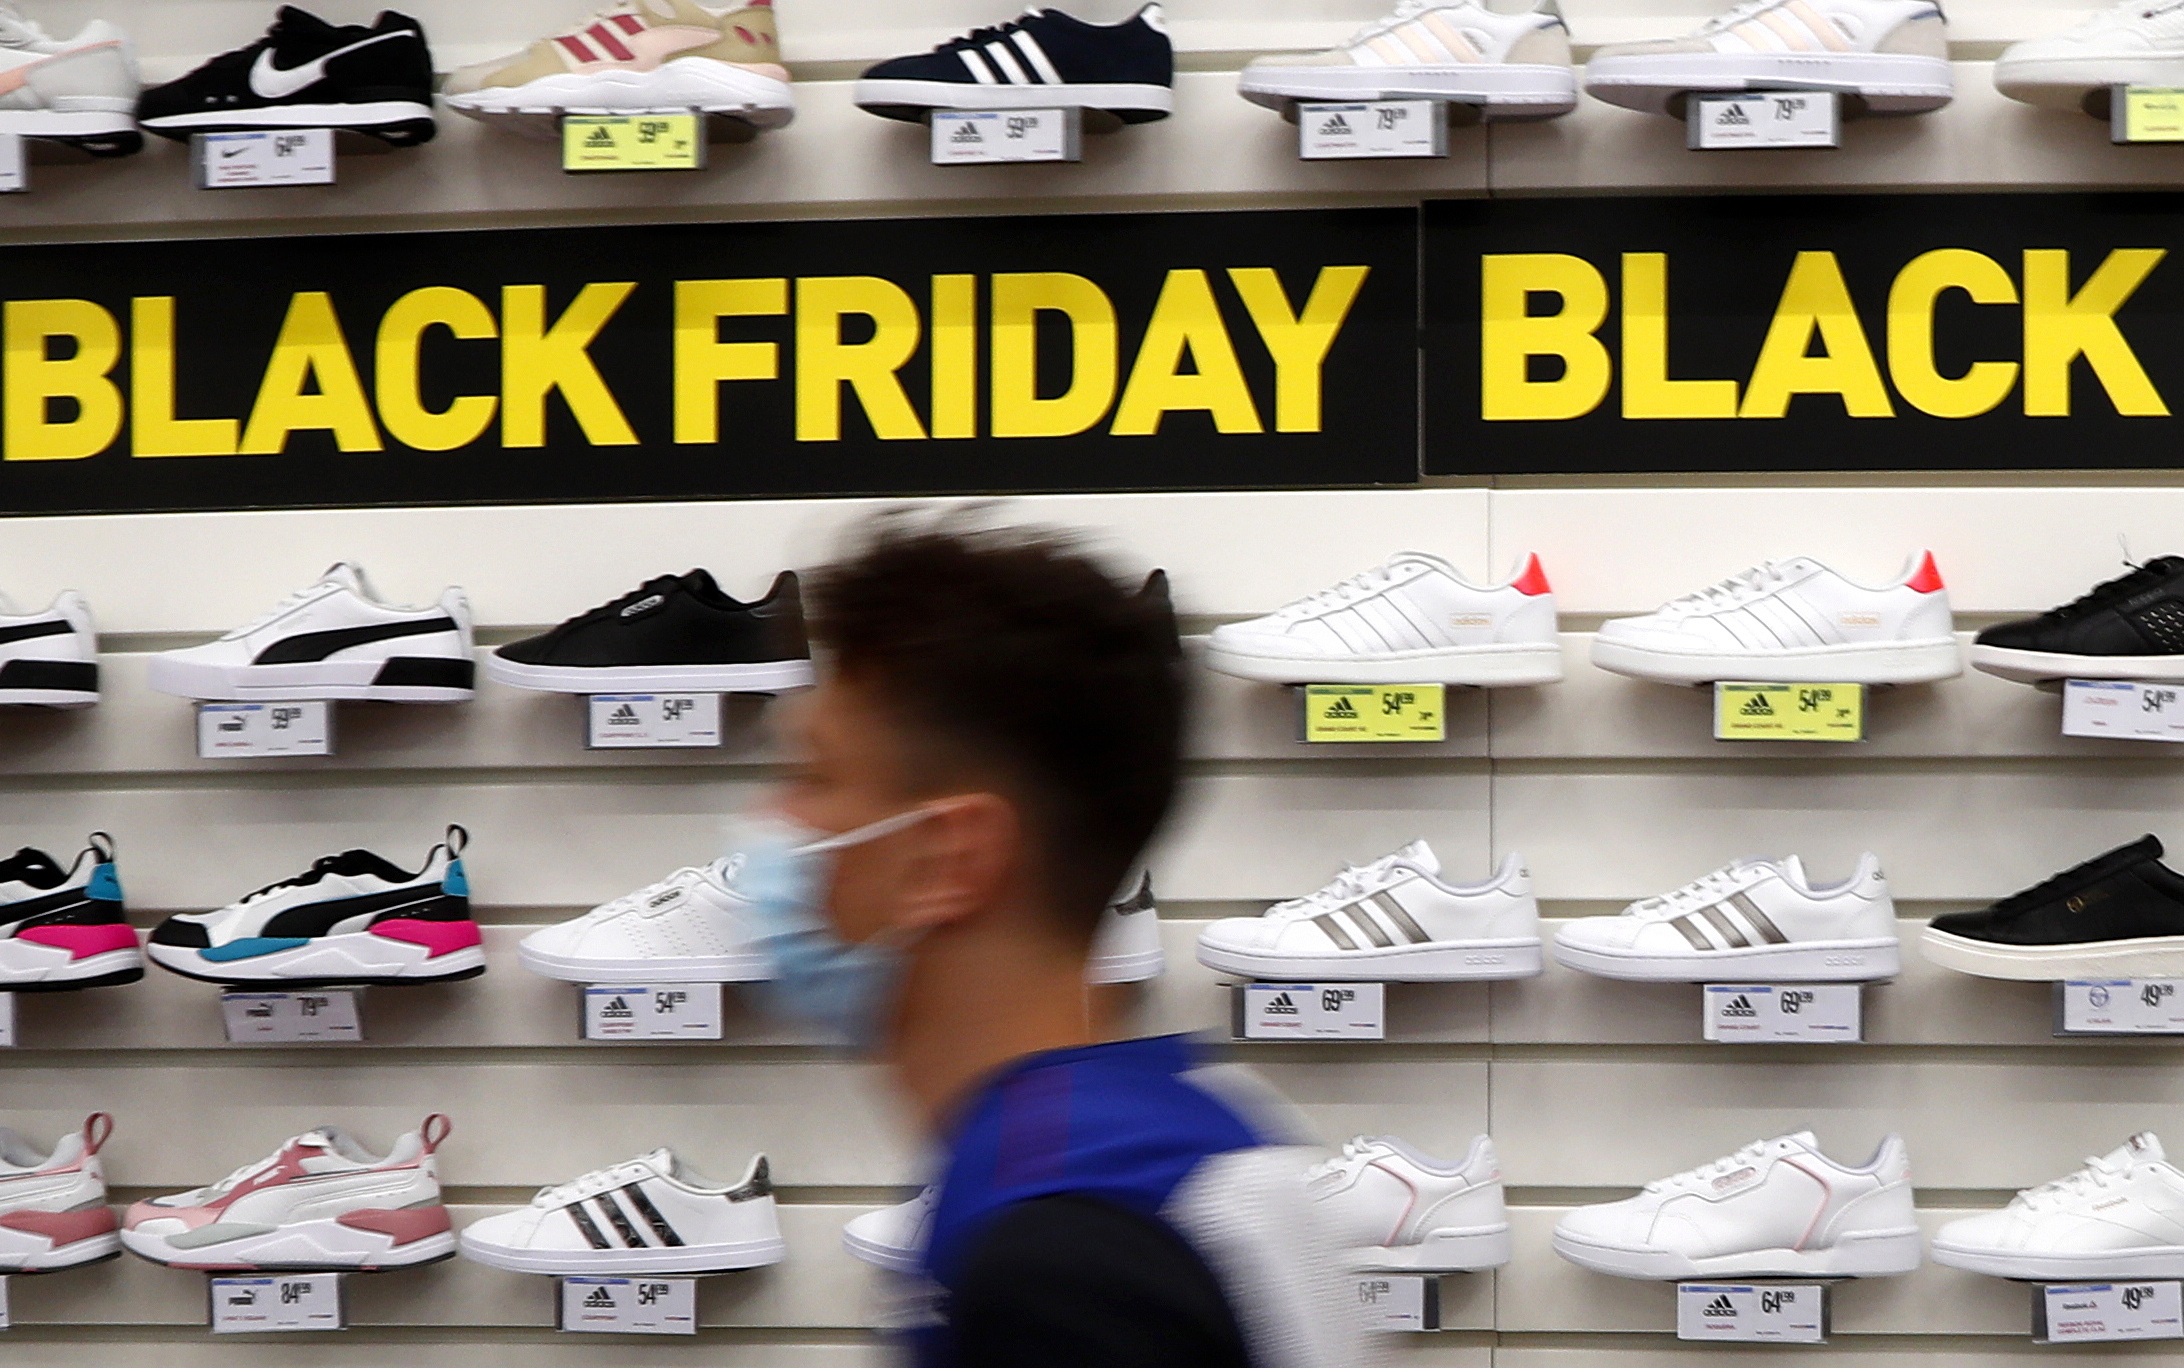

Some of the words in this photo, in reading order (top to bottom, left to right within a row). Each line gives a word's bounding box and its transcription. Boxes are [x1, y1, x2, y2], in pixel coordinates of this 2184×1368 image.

[3, 281, 641, 462] BLACK
[673, 265, 1371, 445] FRIDAY
[1481, 247, 2172, 422] BLACK
